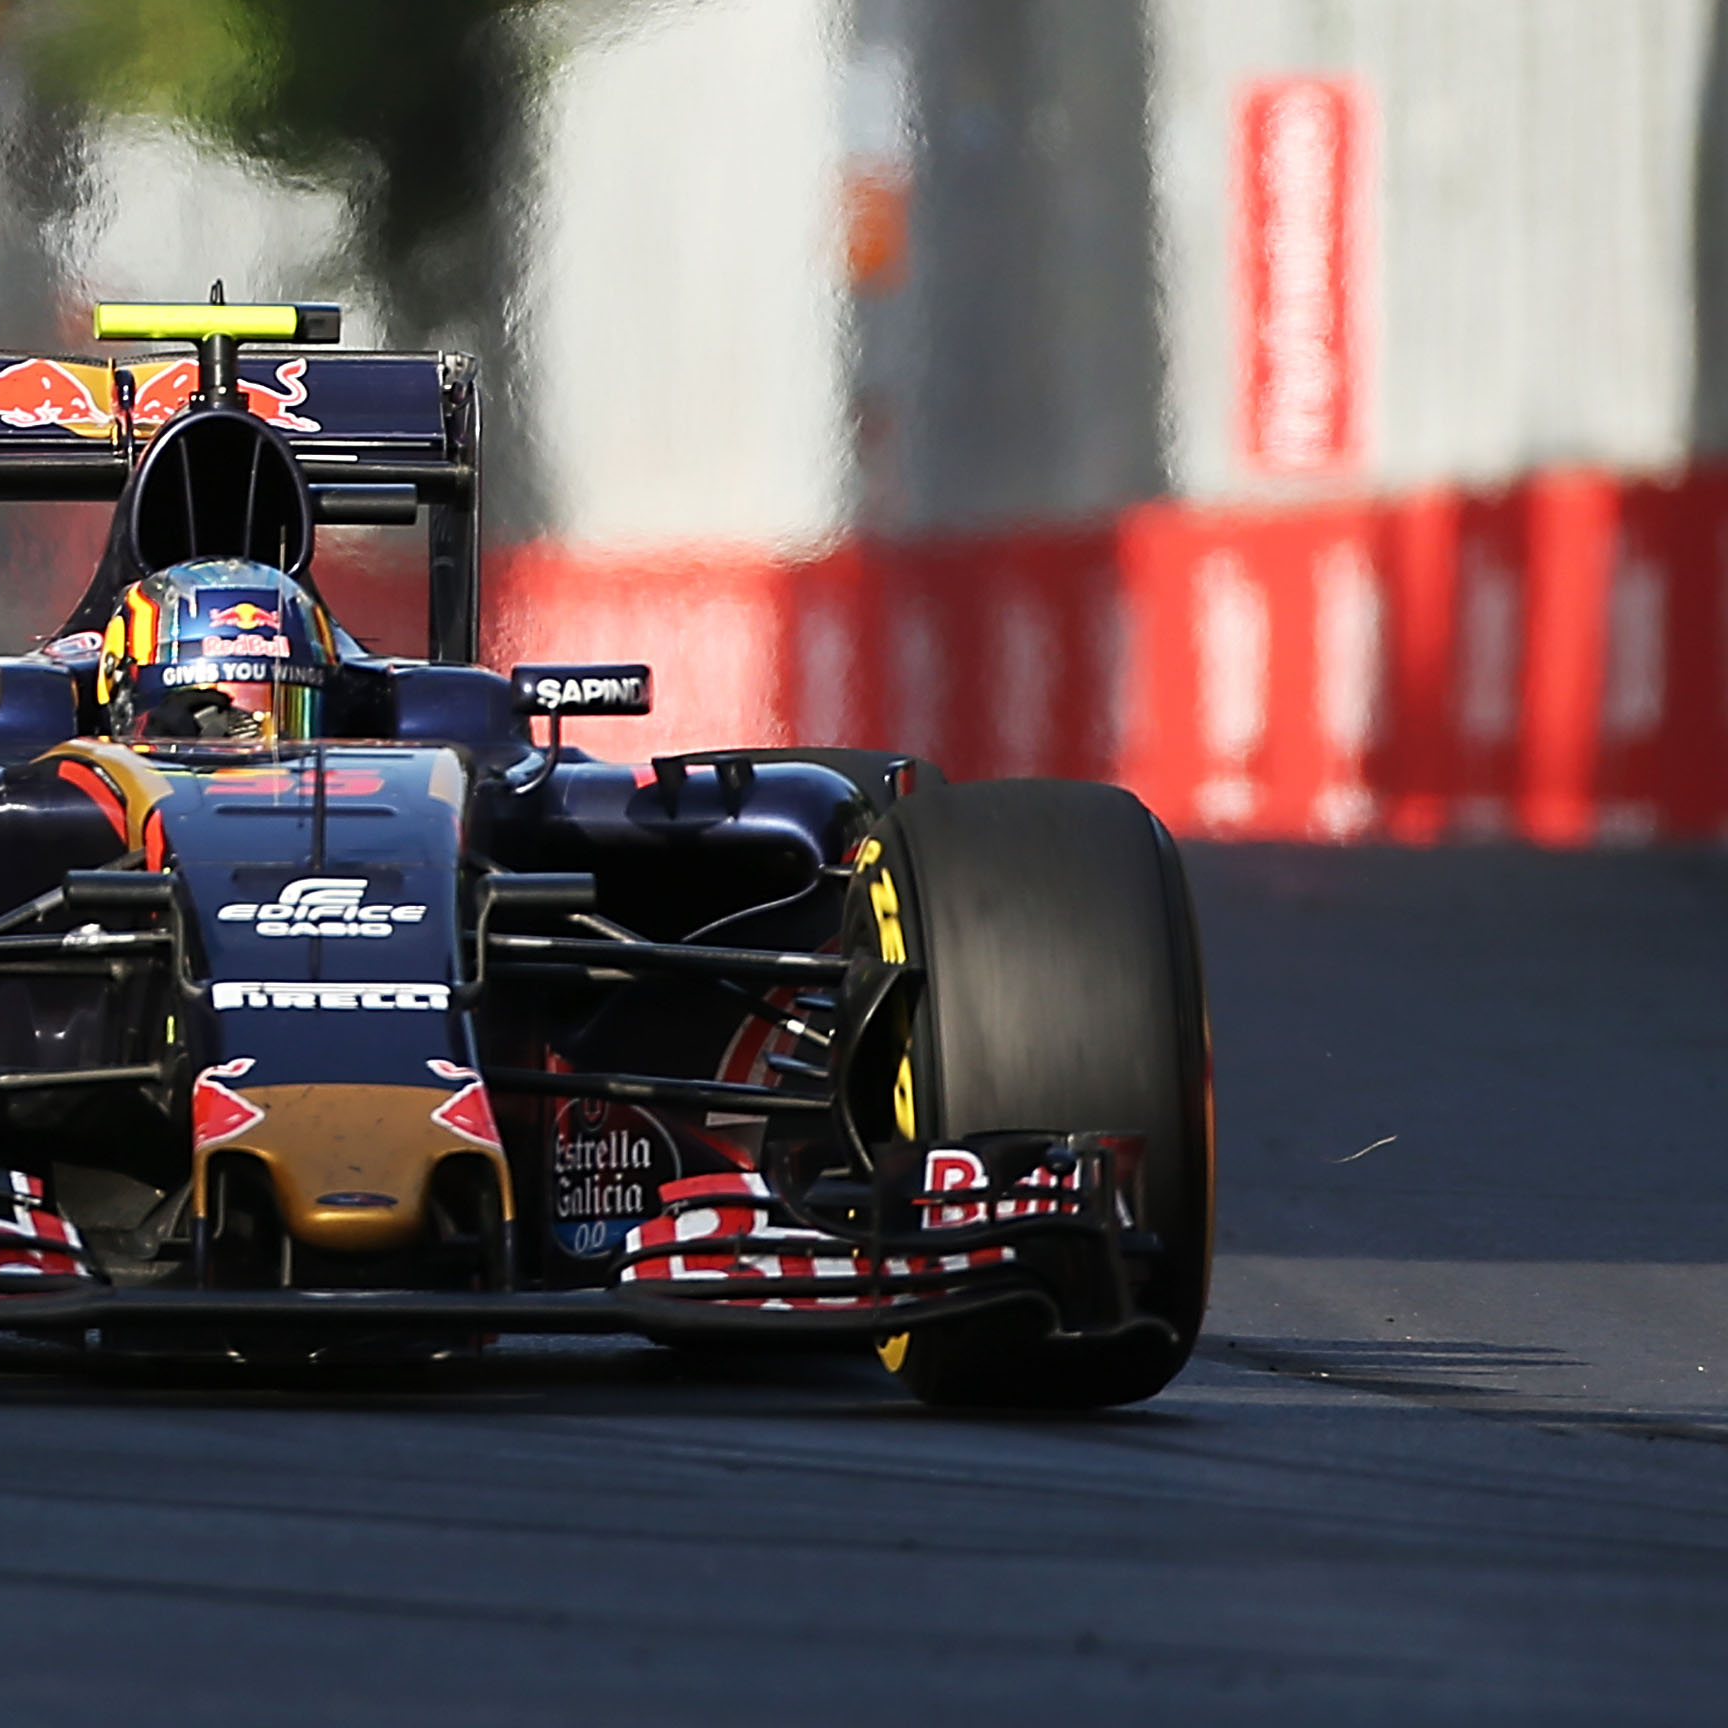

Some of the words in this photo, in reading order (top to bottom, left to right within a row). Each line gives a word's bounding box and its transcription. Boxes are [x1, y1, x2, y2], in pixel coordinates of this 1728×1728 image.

[162, 661, 219, 686] GIVES
[222, 662, 266, 681] YOU
[217, 903, 427, 922] EDIFICE
[255, 922, 393, 937] CASIO
[212, 981, 450, 1011] PIRELLI
[555, 1129, 651, 1172] Estrella
[557, 1173, 644, 1217] Galicia
